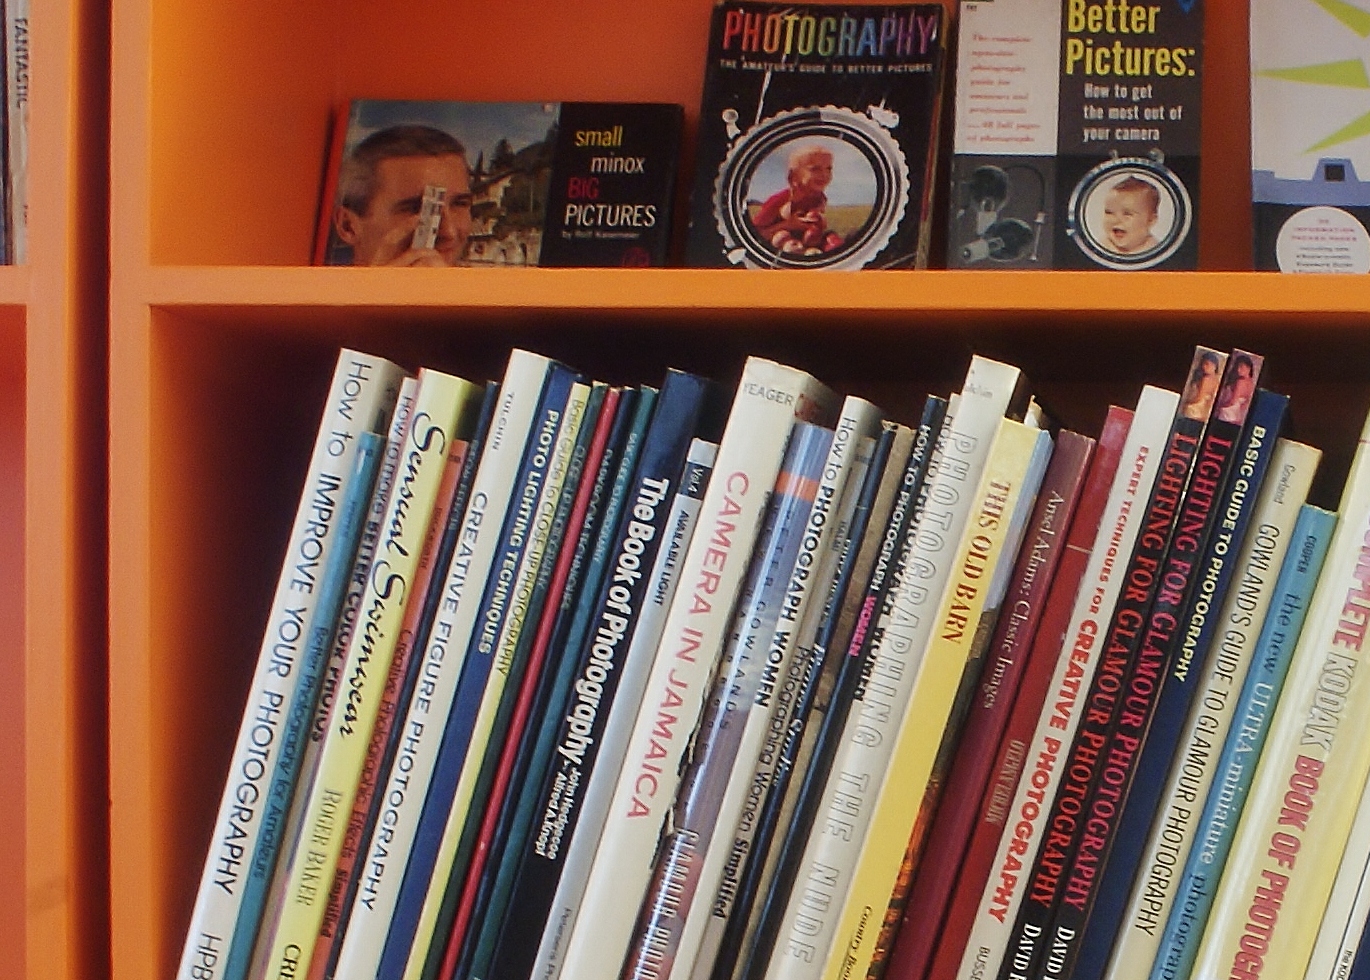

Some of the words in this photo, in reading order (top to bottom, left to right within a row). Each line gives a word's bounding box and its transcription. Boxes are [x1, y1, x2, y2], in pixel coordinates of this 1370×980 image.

[723, 10, 937, 56] PHOTOGRAPHY
[1067, 0, 1161, 34] Better
[720, 58, 737, 69] THE
[832, 63, 845, 74] TO
[849, 63, 883, 74] BETTER
[888, 63, 933, 74] PICTURES
[1066, 38, 1196, 77] Pictures:
[1083, 104, 1104, 120] the
[1108, 105, 1140, 121] most
[1144, 105, 1165, 121] out
[1169, 105, 1183, 121] of
[1084, 83, 1110, 99] How
[1114, 84, 1128, 99] to
[1132, 84, 1153, 102] get
[575, 125, 624, 147] small
[1083, 127, 1110, 143] your
[1115, 127, 1160, 141] camera
[567, 177, 599, 199] BIG
[590, 151, 645, 174] minox
[564, 203, 657, 227] PICTURES
[332, 359, 371, 422] How
[323, 427, 353, 459] to
[1124, 444, 1150, 496] EXPERT
[1172, 432, 1233, 555] LIGHTING
[629, 473, 669, 525] The
[974, 476, 1013, 533] THIS
[287, 471, 340, 594] IMPROVE
[611, 520, 655, 588] Book
[686, 468, 752, 618] CAMERA
[958, 532, 995, 581] OLD
[1096, 500, 1133, 583] TECHNIQUES
[603, 584, 636, 615] of
[1087, 587, 1106, 615] FOR
[1155, 557, 1192, 609] FOR
[938, 581, 979, 645] BARN
[265, 603, 307, 680] YOUR
[672, 625, 705, 665] IN
[553, 609, 628, 766] Photography
[1047, 617, 1101, 732] CREATIVE
[1118, 608, 1178, 731] GLAMOUR
[624, 666, 693, 824] JAMAICA
[210, 689, 285, 896] PHOTOGRAPHY
[984, 735, 1063, 925] PHOTOGRAPHY
[1060, 730, 1141, 914] PHOTOGRAPHY
[1043, 925, 1076, 976] DAVID
